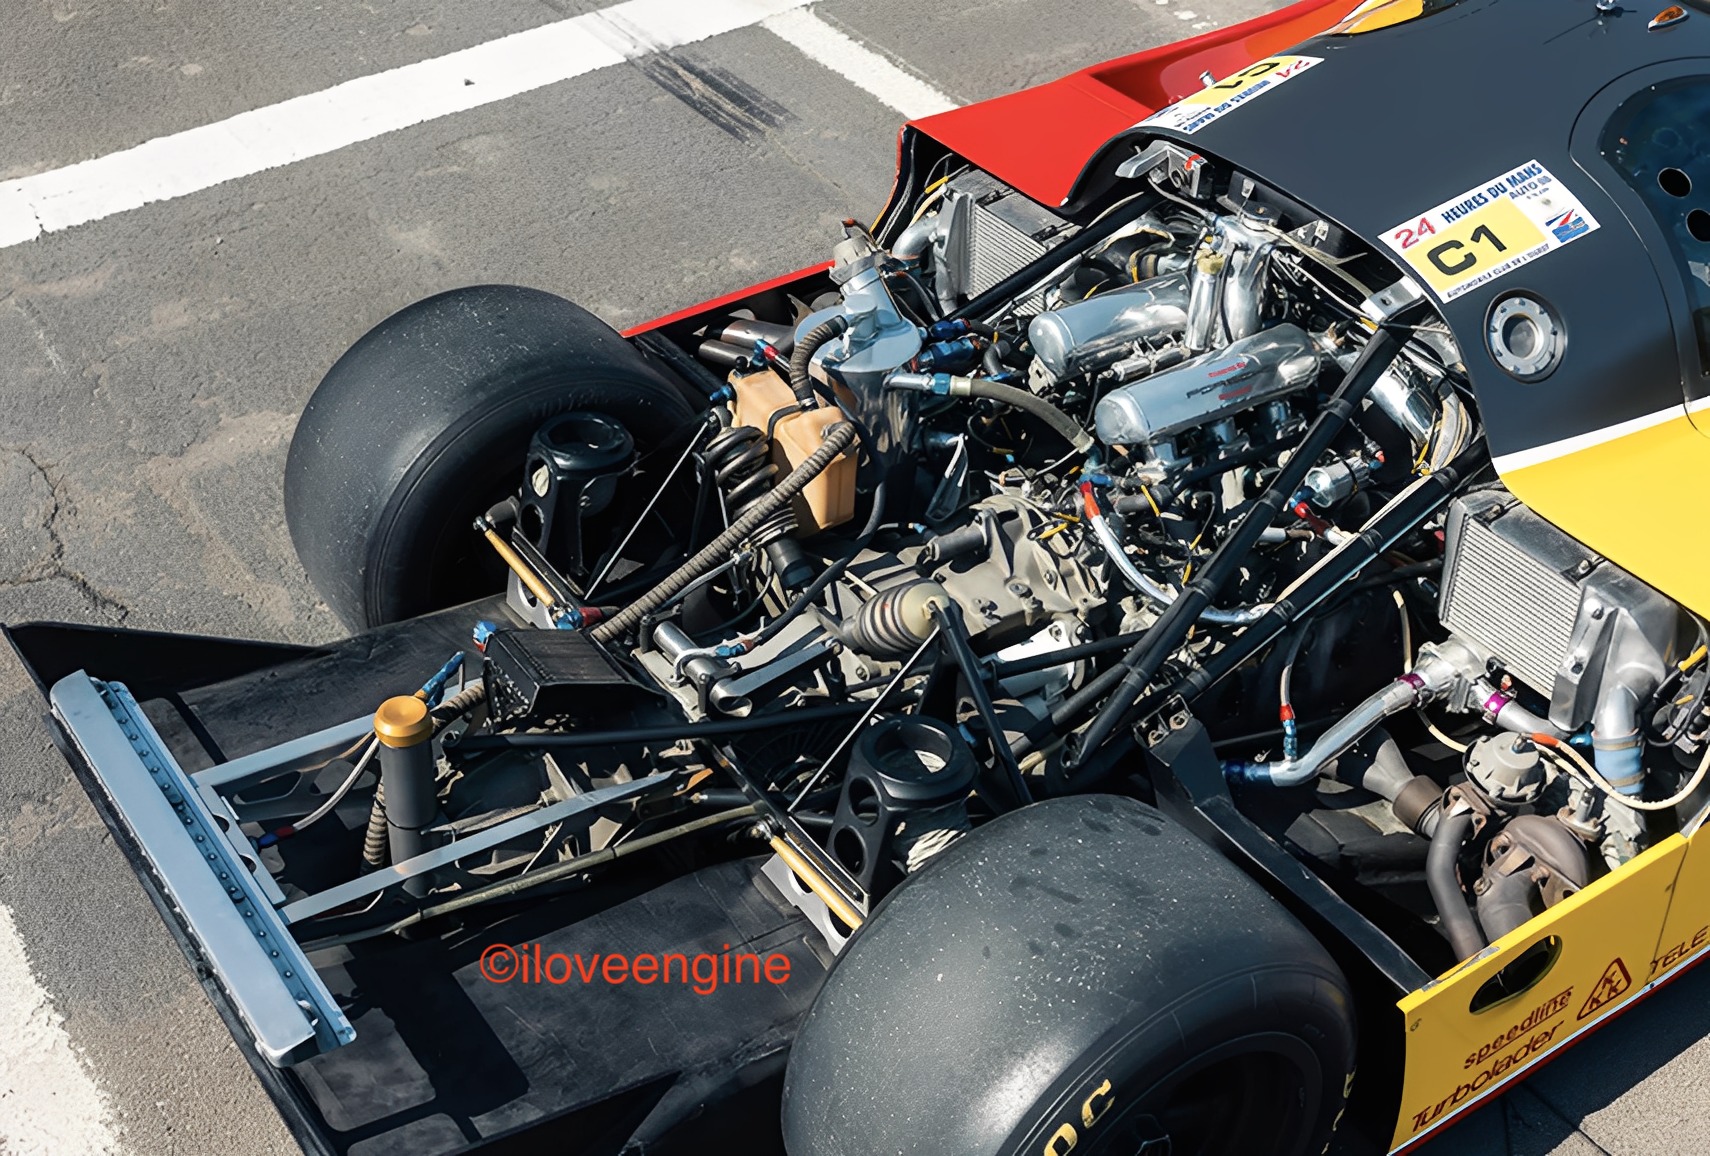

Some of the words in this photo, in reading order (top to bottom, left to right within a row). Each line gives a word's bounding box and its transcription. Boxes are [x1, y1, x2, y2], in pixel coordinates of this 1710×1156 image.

[1394, 217, 1436, 249] 24
[1441, 192, 1489, 224] HEURES
[1486, 182, 1509, 199] DU
[1427, 224, 1507, 276] C1
[1464, 985, 1574, 1069] speedline
[1412, 1020, 1564, 1132] Turbolader
